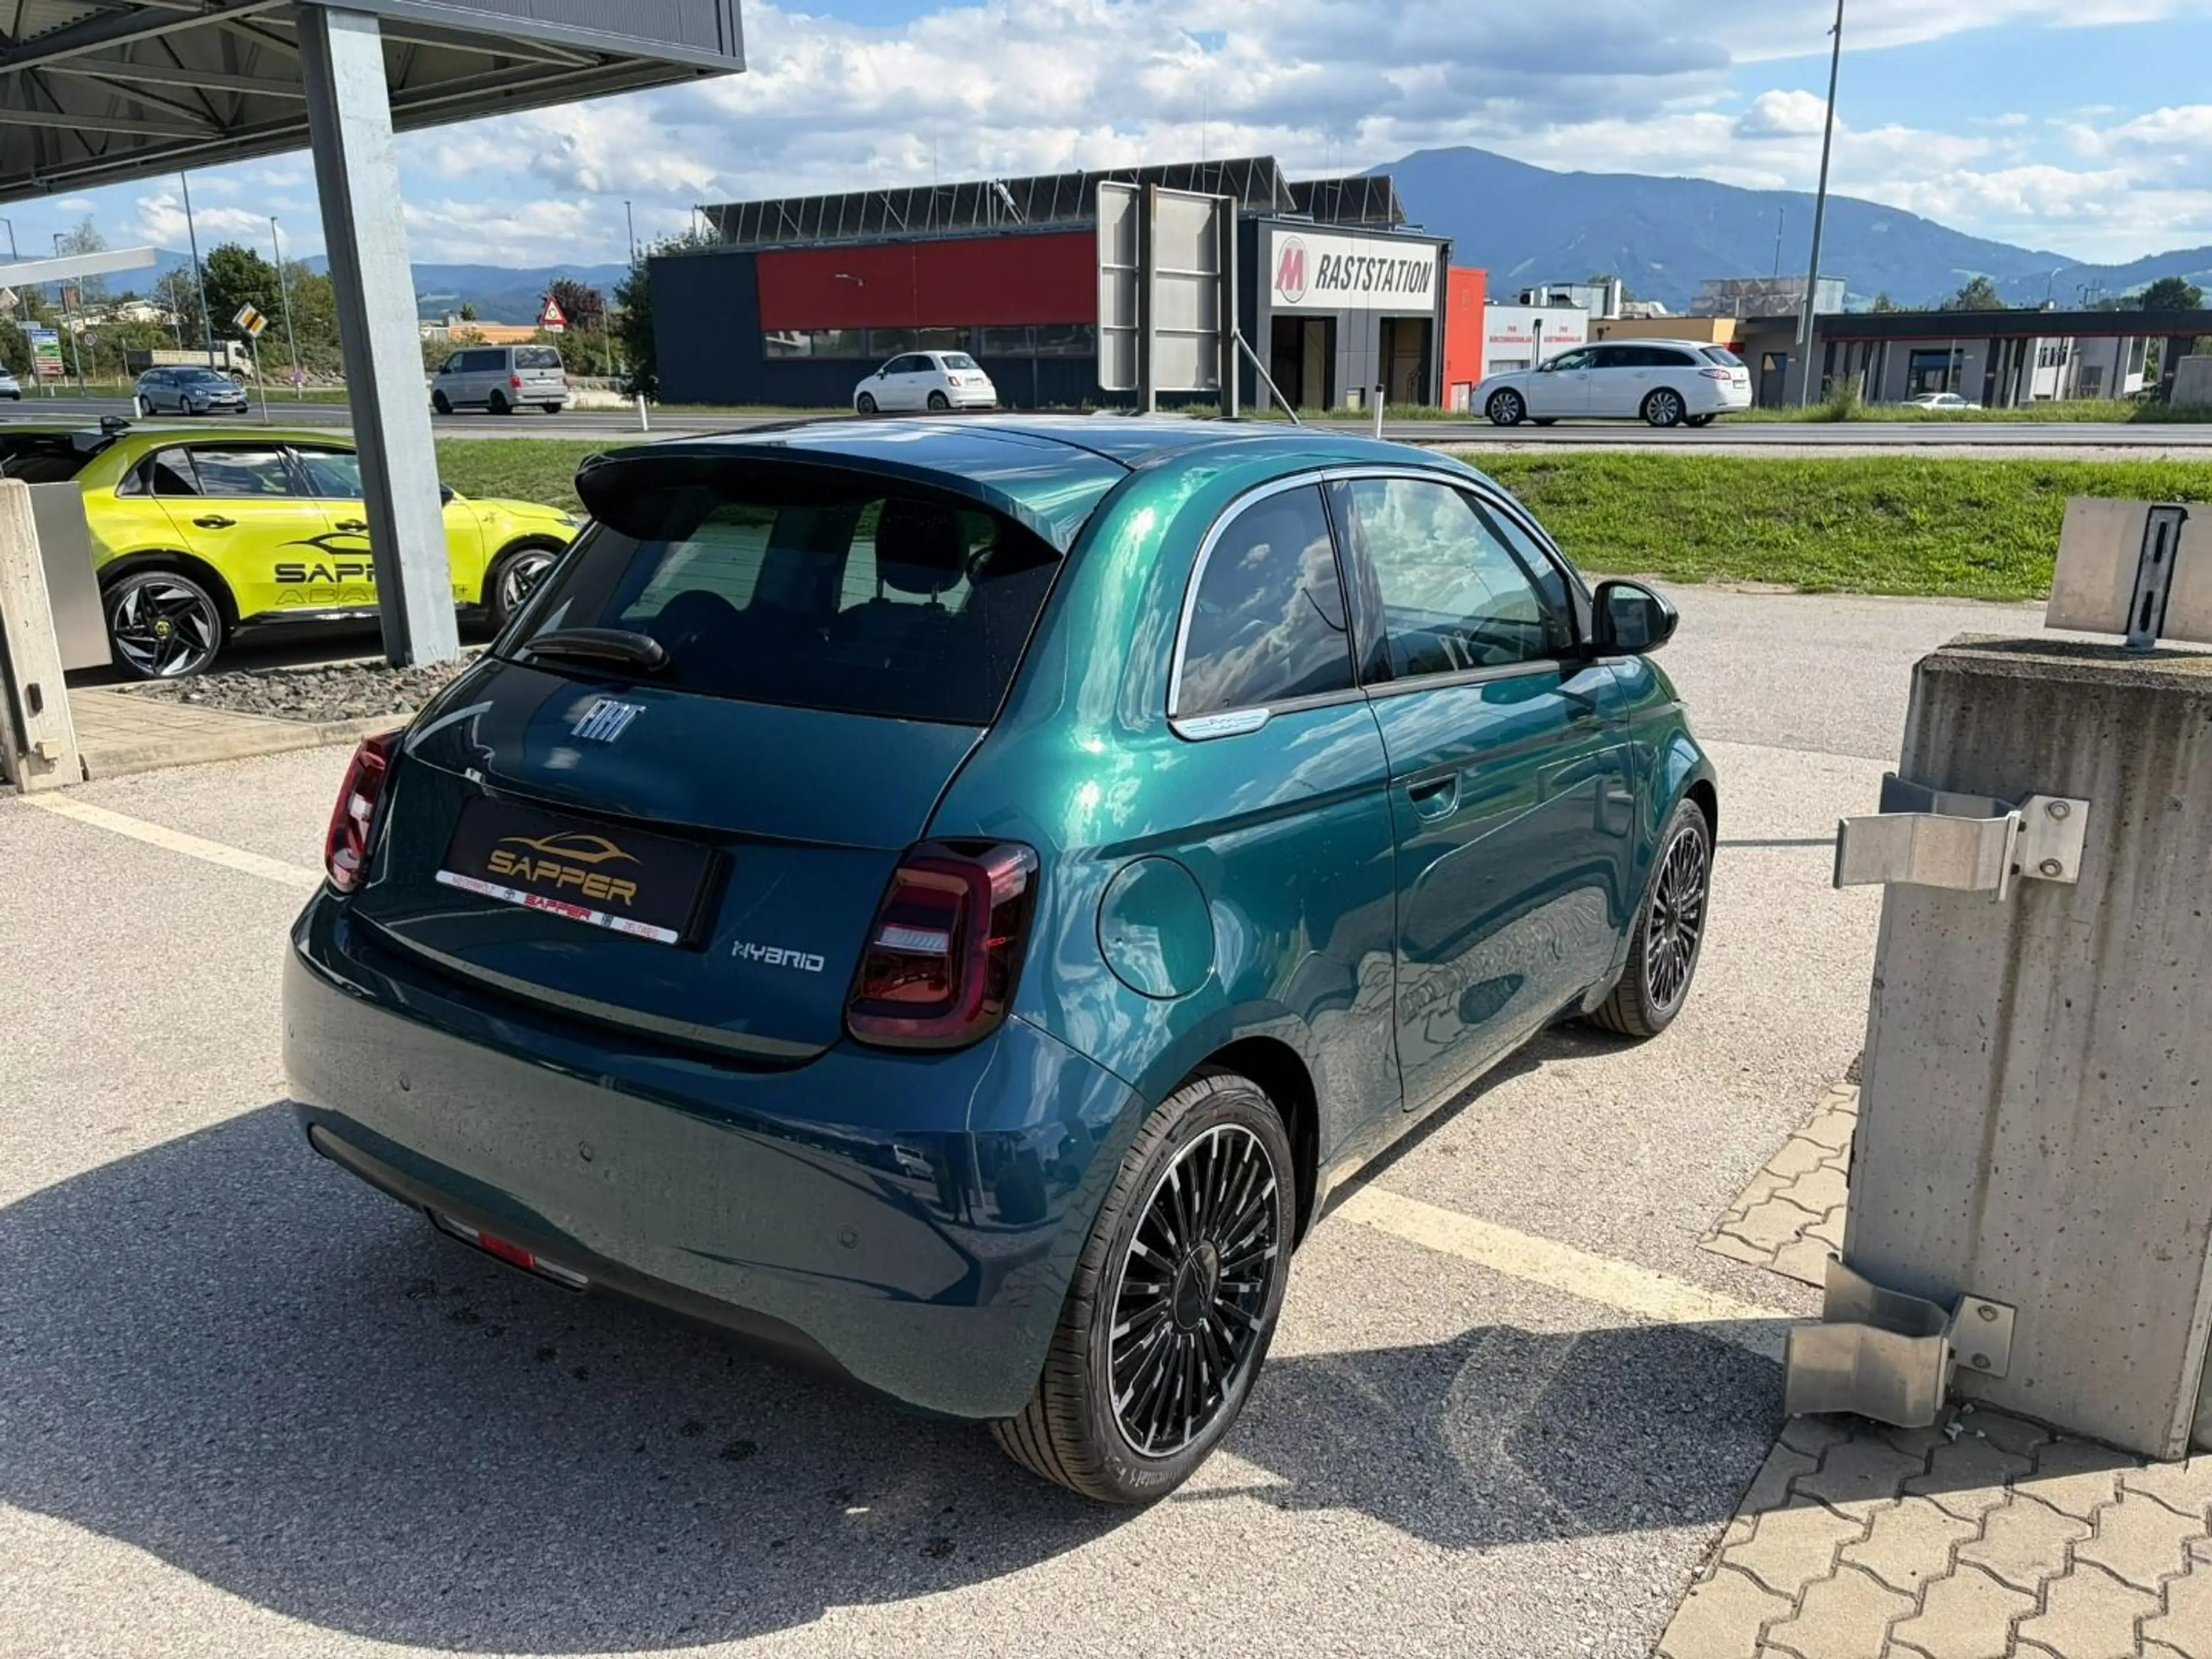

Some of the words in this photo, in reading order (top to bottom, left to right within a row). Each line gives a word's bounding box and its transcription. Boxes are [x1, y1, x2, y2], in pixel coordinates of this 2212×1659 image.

[1315, 253, 1432, 293] RASTSTATION
[571, 699, 646, 742] FIAT
[487, 849, 637, 907] SAPPER
[524, 895, 591, 921] SAPPER
[732, 940, 824, 972] HYBRID
